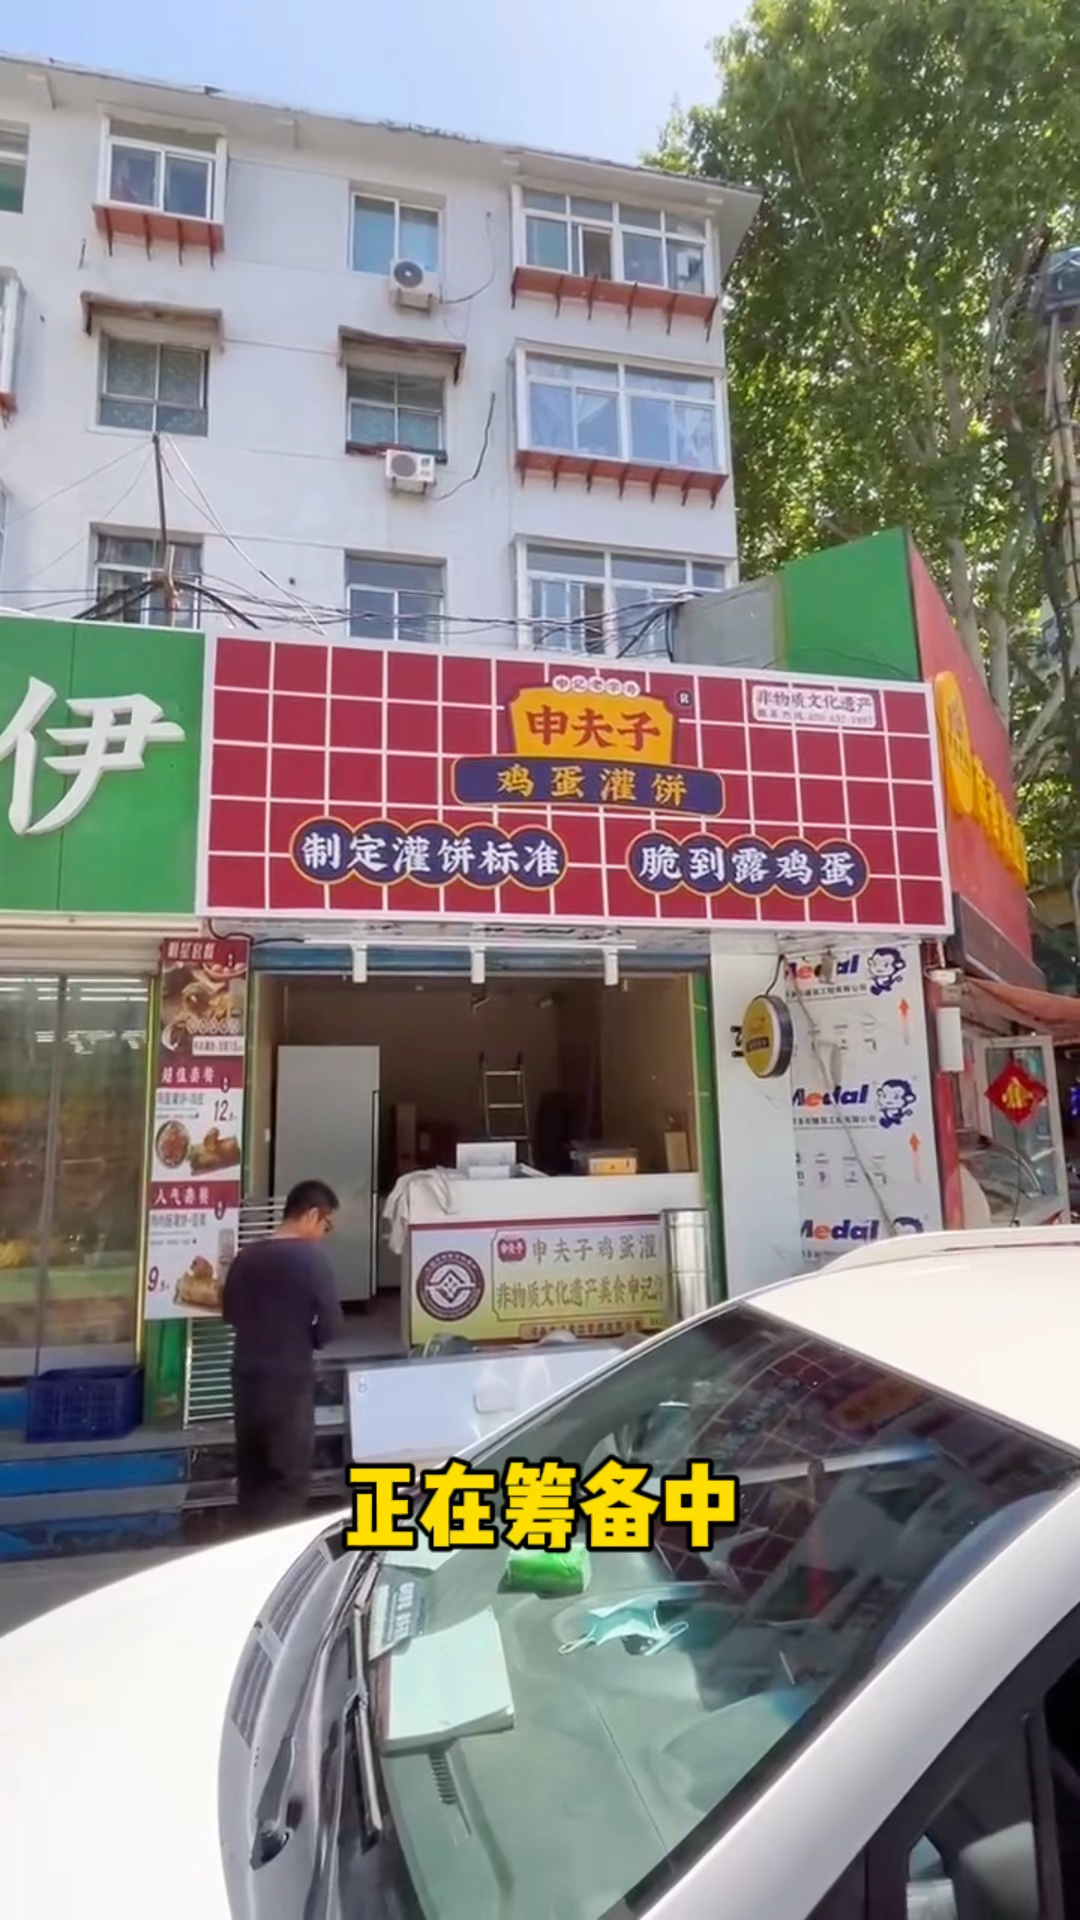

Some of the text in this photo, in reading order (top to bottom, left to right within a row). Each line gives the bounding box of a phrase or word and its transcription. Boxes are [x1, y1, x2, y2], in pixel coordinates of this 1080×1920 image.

[758, 689, 873, 713] 非物质文化遗产
[525, 704, 661, 751] 申夫子
[0, 676, 186, 836] 伊
[497, 763, 688, 806] 鸡蛋灌饼
[301, 831, 561, 878] 制定灌饼标准
[638, 843, 855, 887] 脆到露鸡蛋
